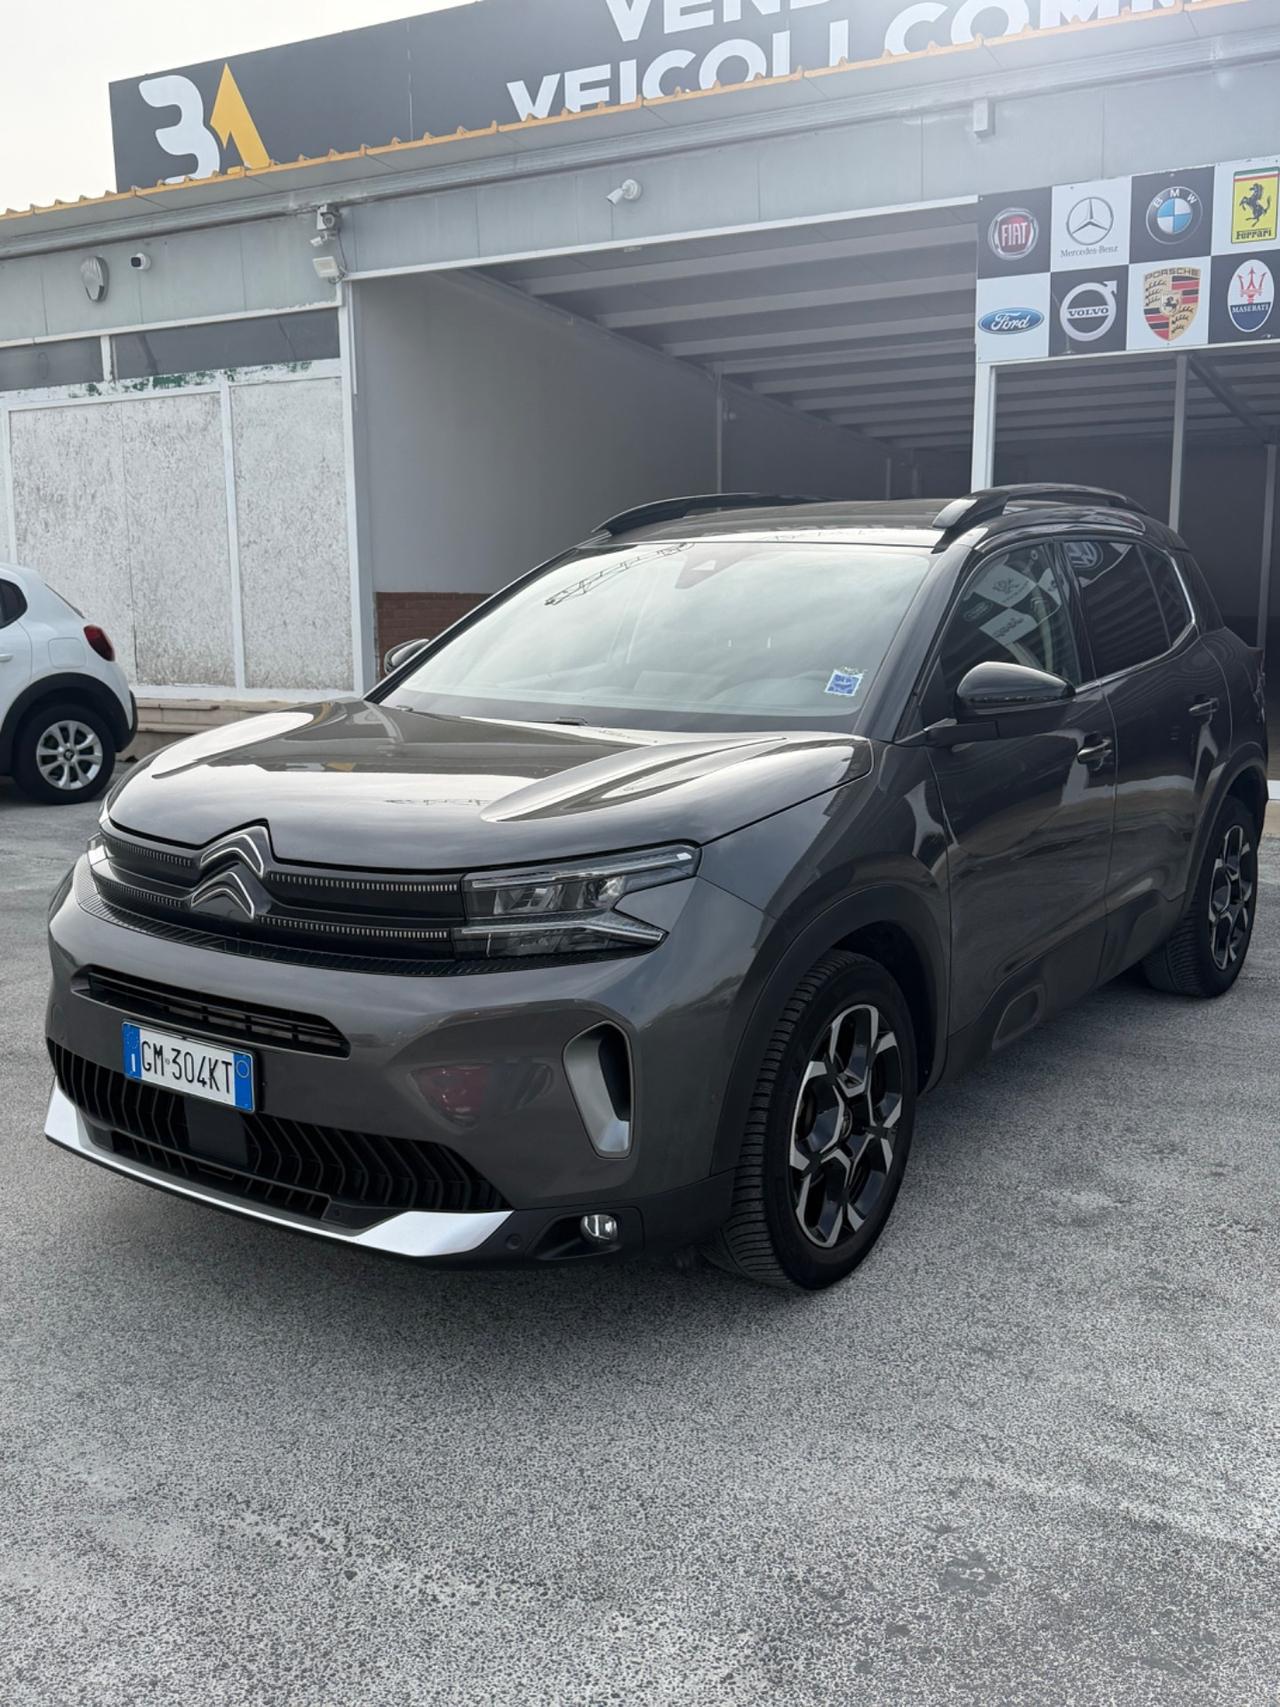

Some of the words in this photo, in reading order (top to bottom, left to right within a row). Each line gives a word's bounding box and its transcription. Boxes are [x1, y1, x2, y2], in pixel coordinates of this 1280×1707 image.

[607, 0, 833, 42] VE
[1001, 222, 1028, 247] FIAT
[1235, 228, 1272, 240] Ferrari
[1144, 267, 1201, 281] PORSCHE
[1067, 306, 1110, 317] VOLVO
[1232, 303, 1270, 314] MASERATI
[990, 311, 1029, 331] Ford
